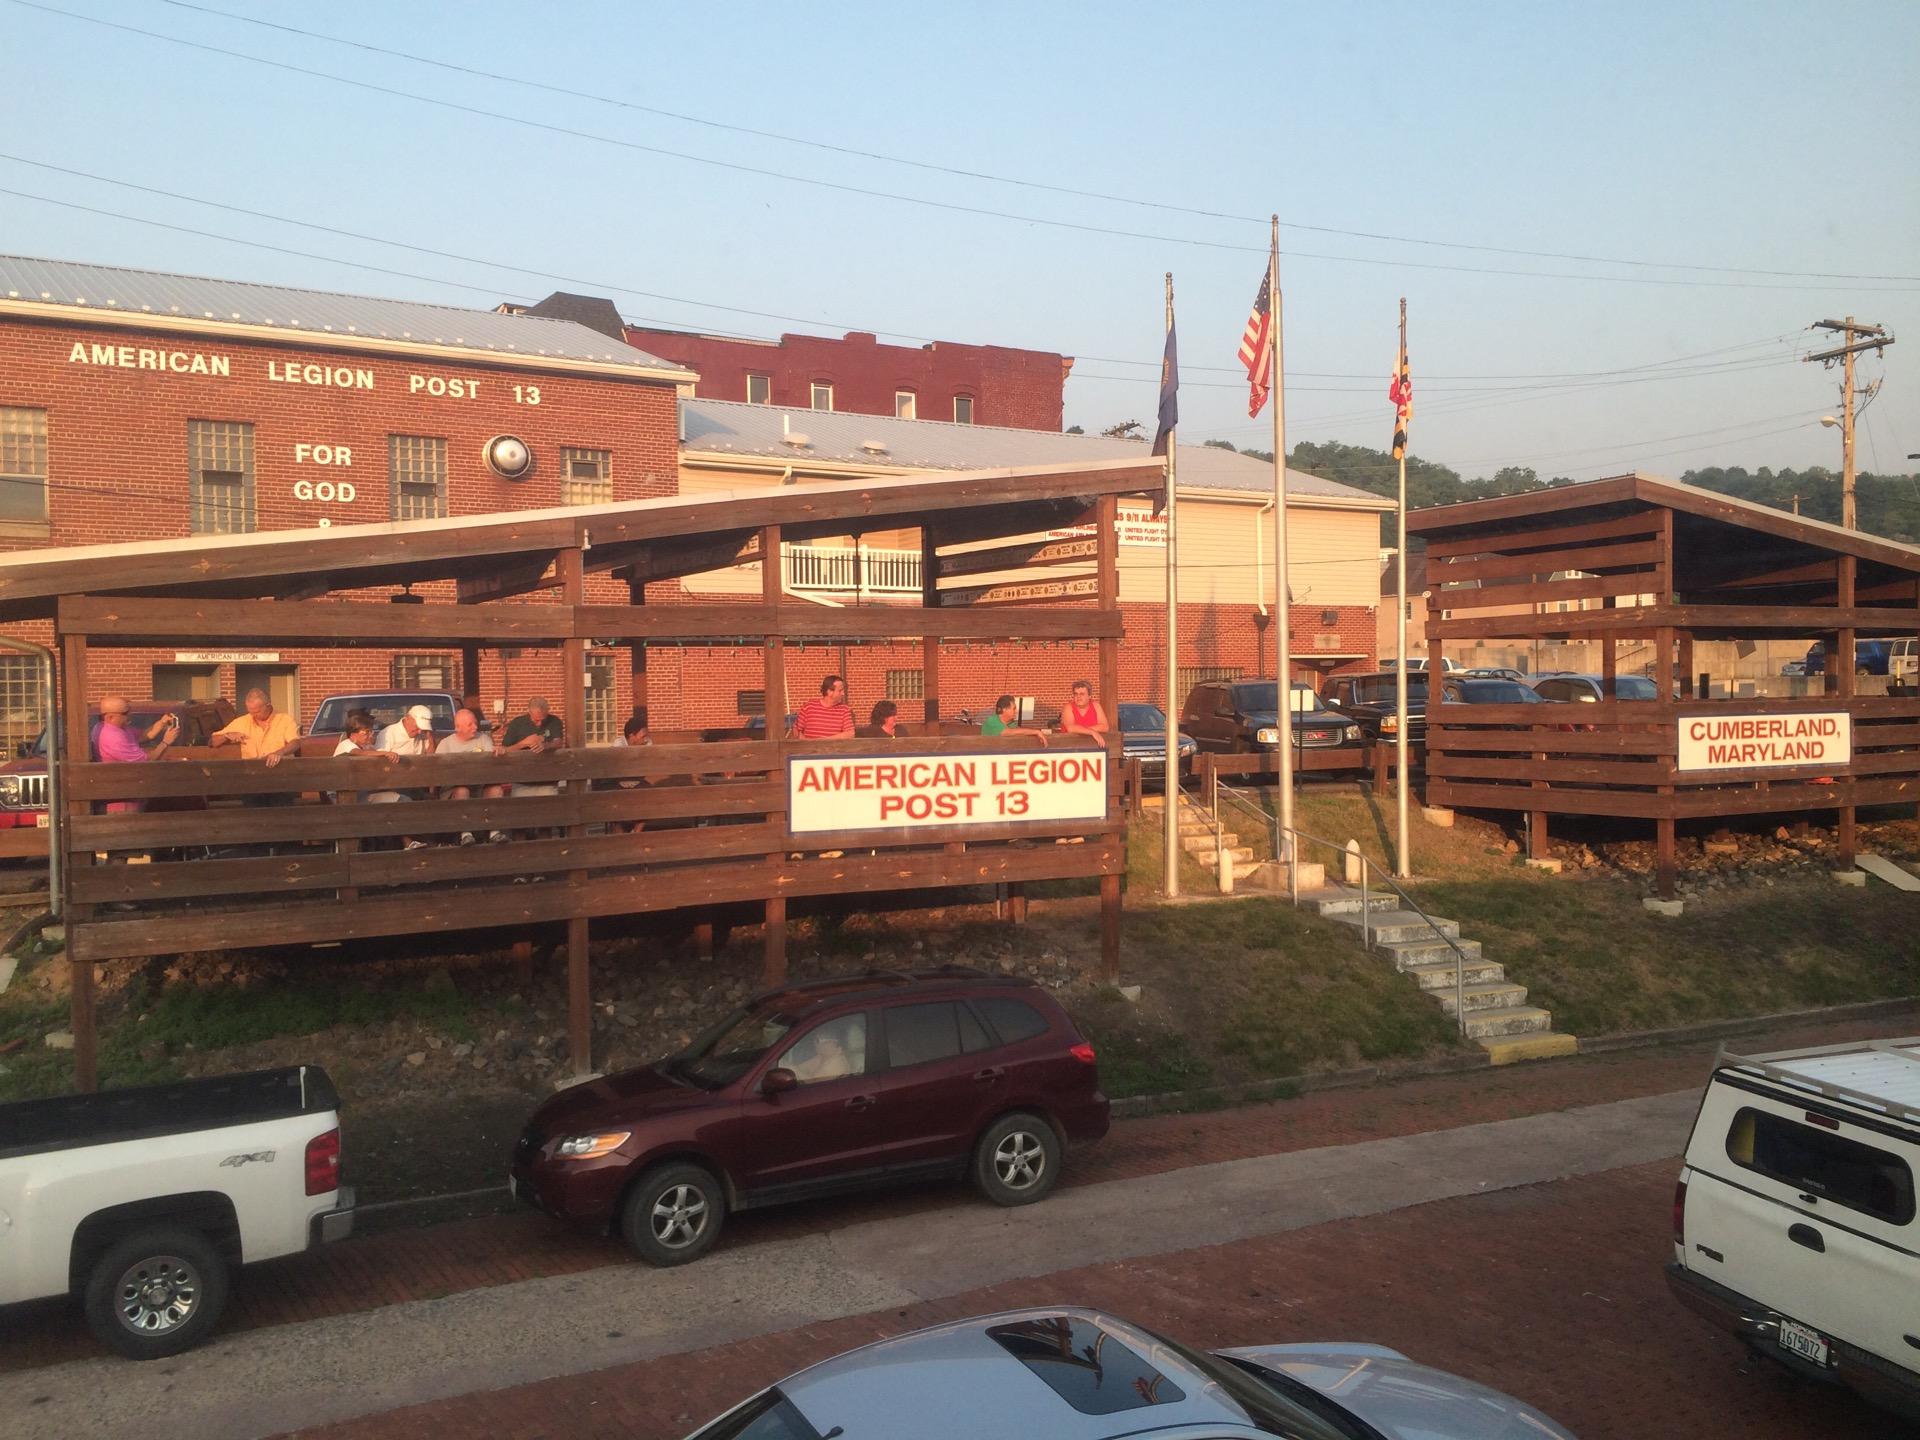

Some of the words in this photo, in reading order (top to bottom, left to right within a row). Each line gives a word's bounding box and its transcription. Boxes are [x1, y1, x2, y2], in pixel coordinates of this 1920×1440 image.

[68, 342, 230, 377] AMERICAN
[268, 361, 374, 390] LEGION
[410, 374, 480, 399] POST
[513, 385, 541, 405] 13
[295, 443, 352, 466] FOR
[293, 480, 356, 502] GOD
[1126, 512, 1139, 522] 9/11
[1690, 718, 1841, 741] CUMBERLAND,
[1708, 741, 1824, 764] MARYLAND
[798, 762, 976, 792] AMERICAN
[991, 758, 1102, 785] LEGION
[880, 793, 980, 820] POST
[996, 790, 1029, 815] 13
